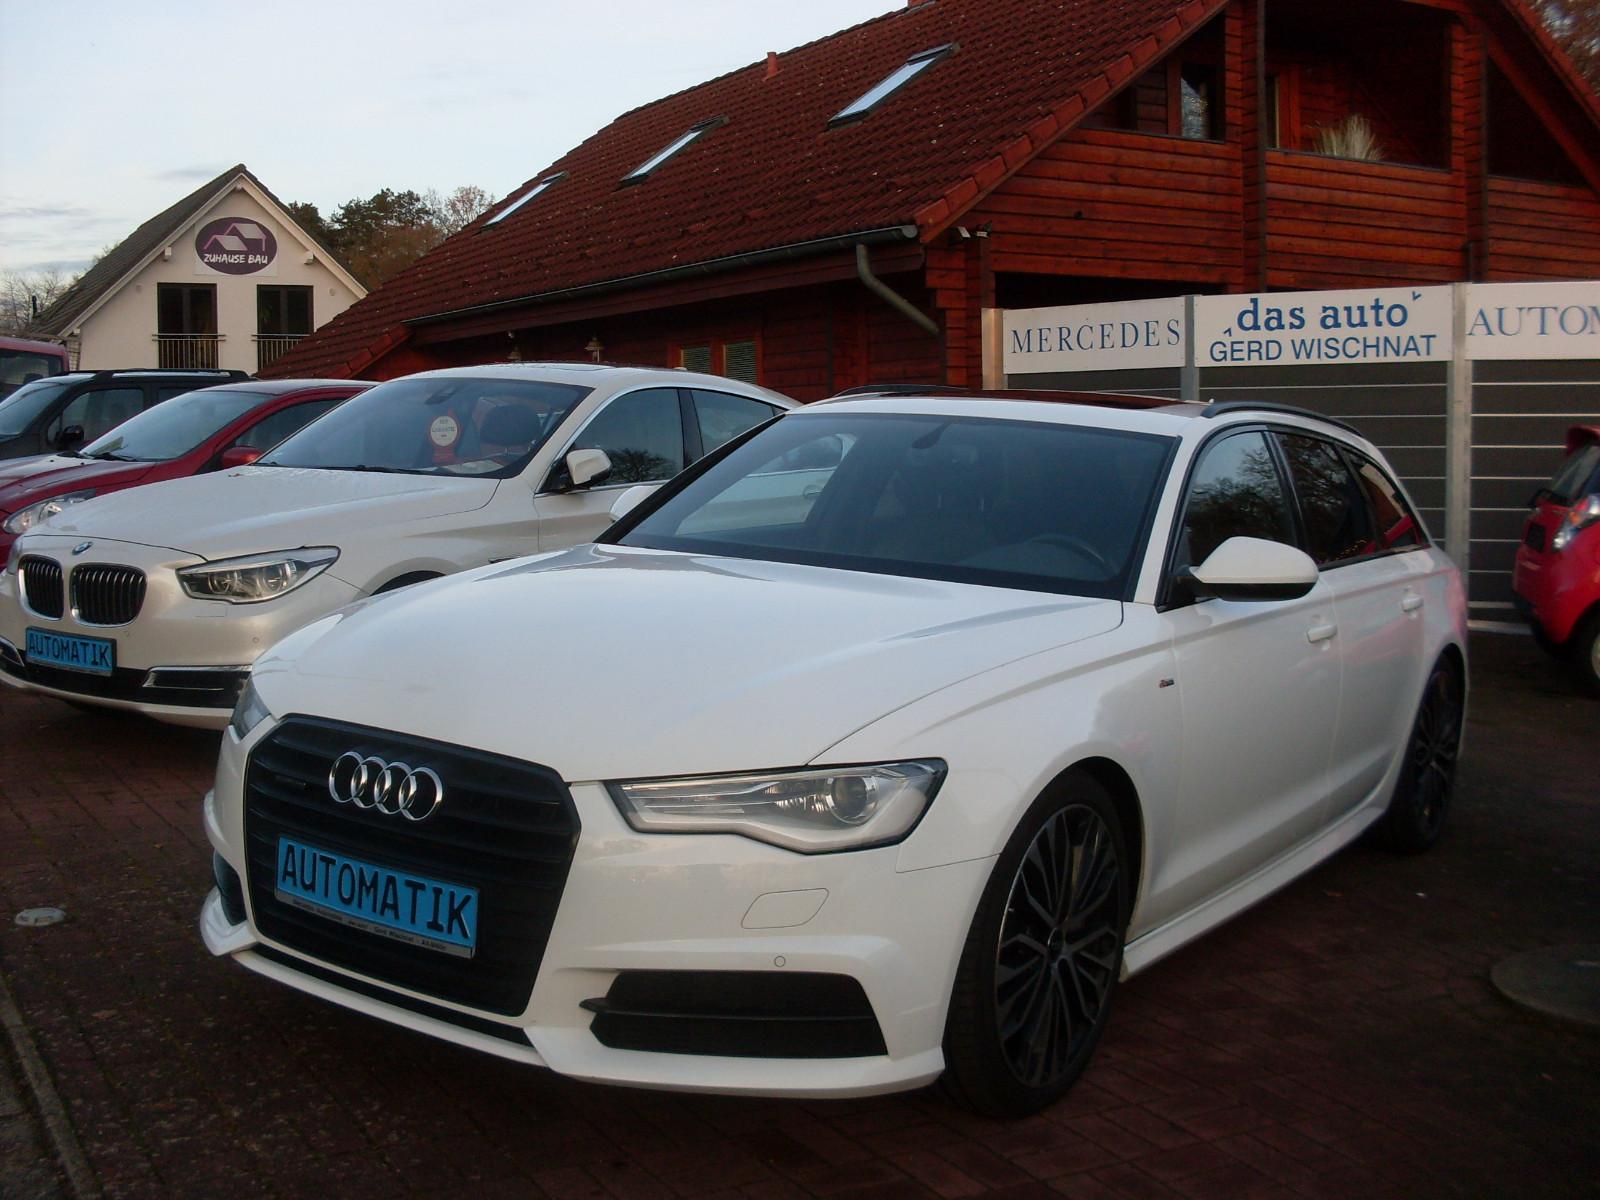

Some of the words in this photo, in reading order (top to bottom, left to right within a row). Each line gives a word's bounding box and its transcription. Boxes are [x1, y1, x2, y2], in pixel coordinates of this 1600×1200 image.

[203, 253, 246, 264] ZUHAUSE
[247, 254, 268, 264] BAU
[1236, 297, 1306, 331] das
[1319, 297, 1409, 330] auto
[1011, 318, 1181, 354] MERCEDES
[1209, 339, 1283, 362] GERD
[1290, 334, 1438, 361] WISCHNAT
[27, 631, 112, 668] AUTOMATIK
[281, 843, 473, 940] AUTOMATIK
